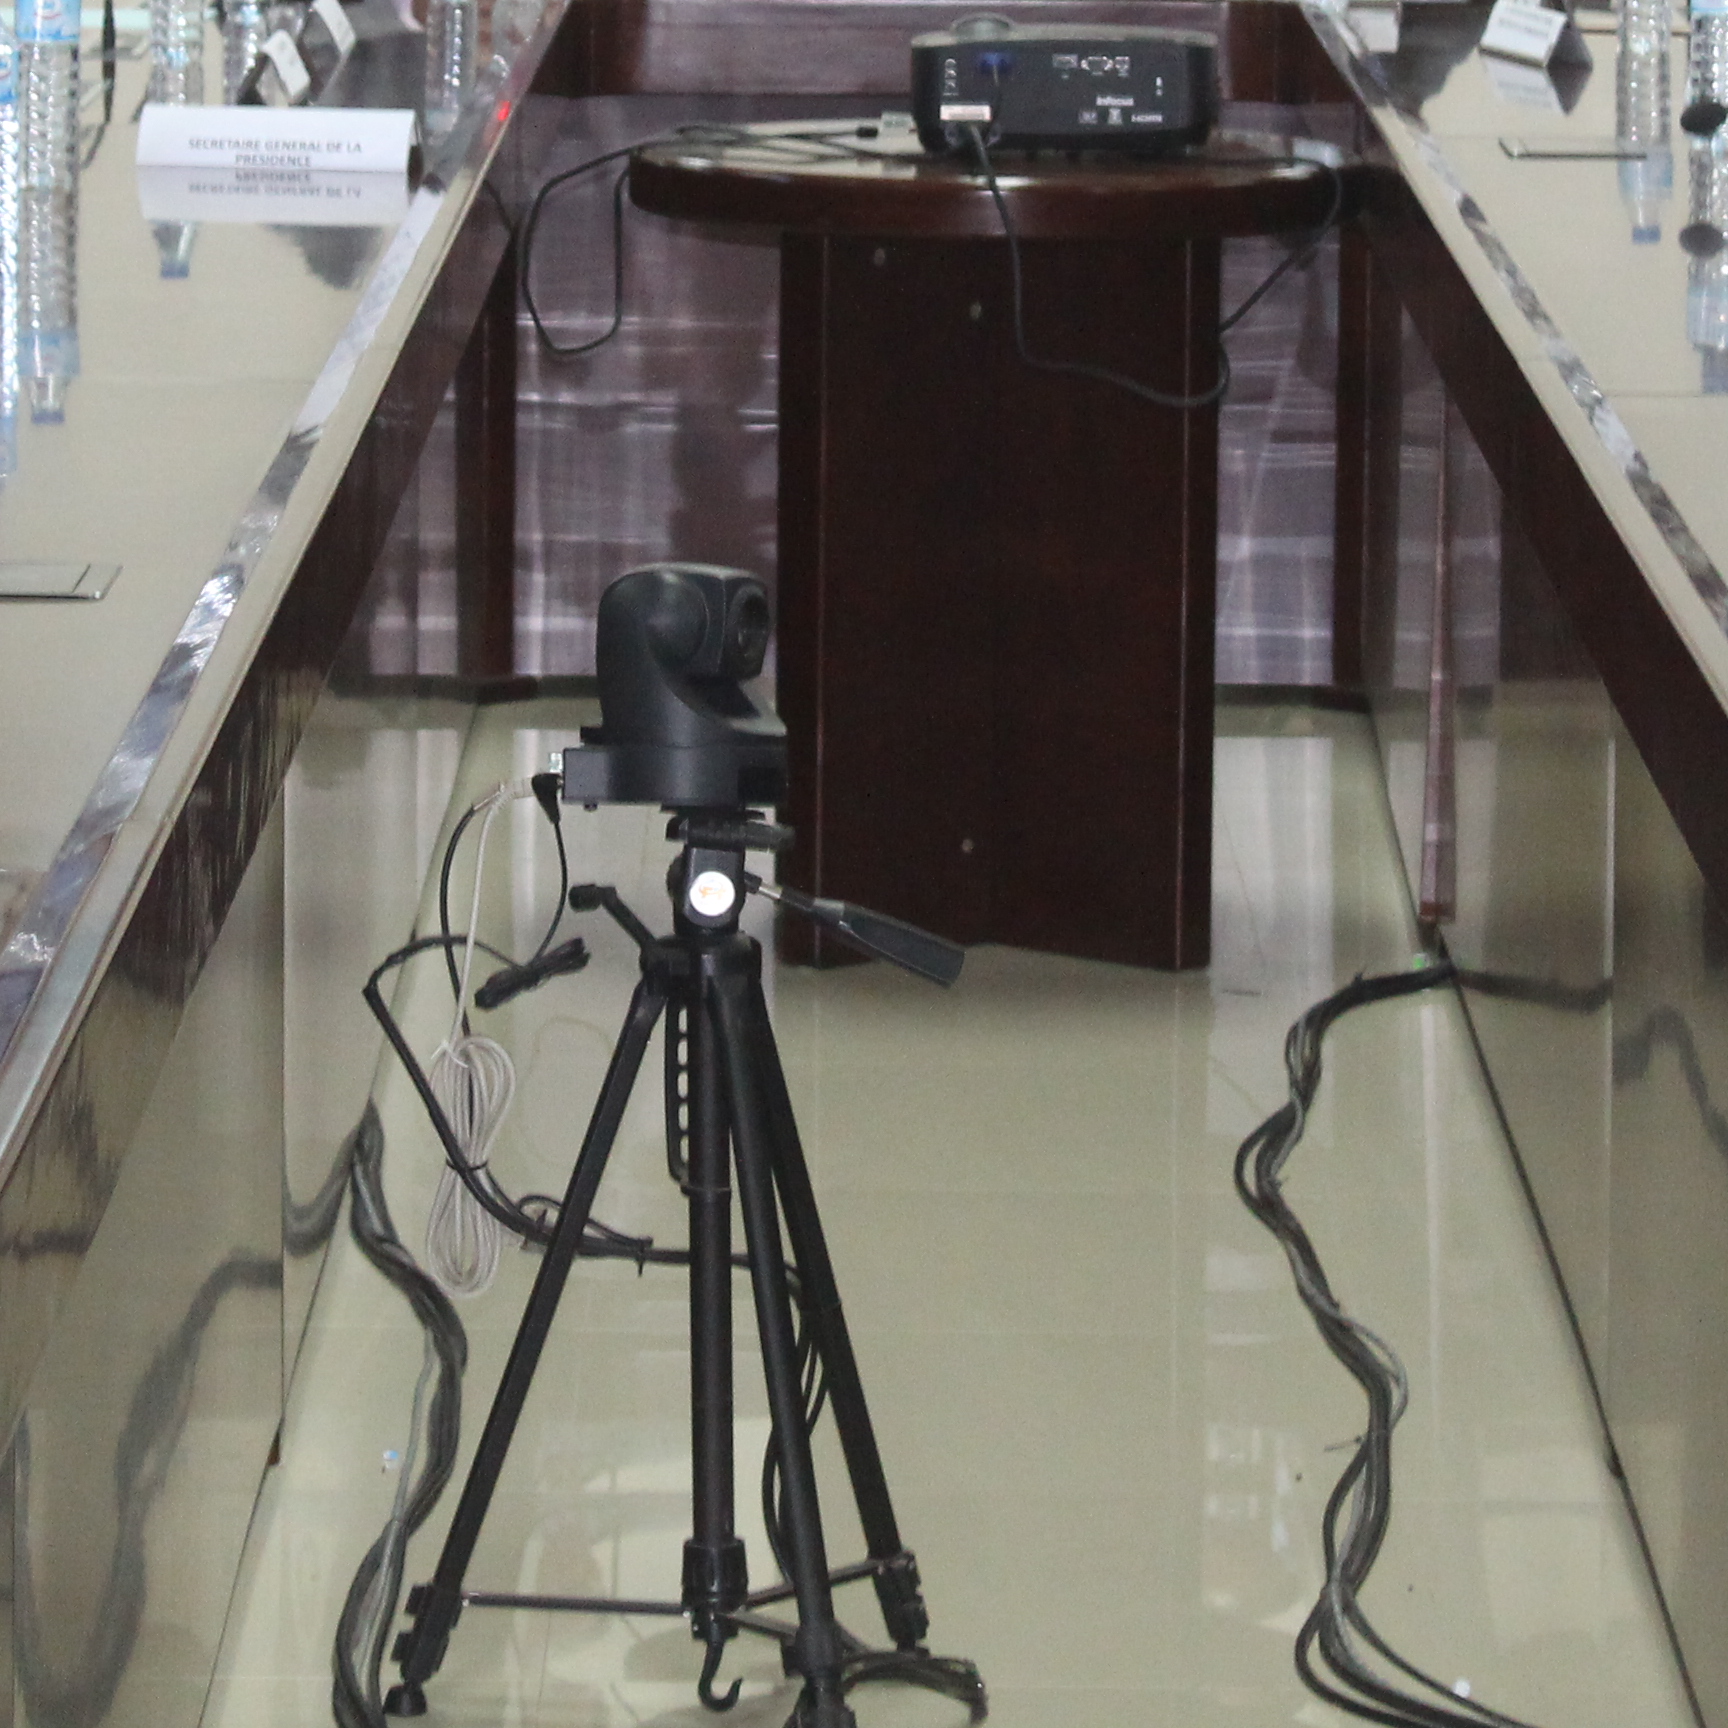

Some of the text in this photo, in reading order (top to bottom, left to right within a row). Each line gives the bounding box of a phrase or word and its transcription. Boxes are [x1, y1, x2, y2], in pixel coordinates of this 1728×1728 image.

[188, 138, 362, 154] SECRETAIRE GENERAL DE LA
[235, 153, 311, 167] PRESIDENCE
